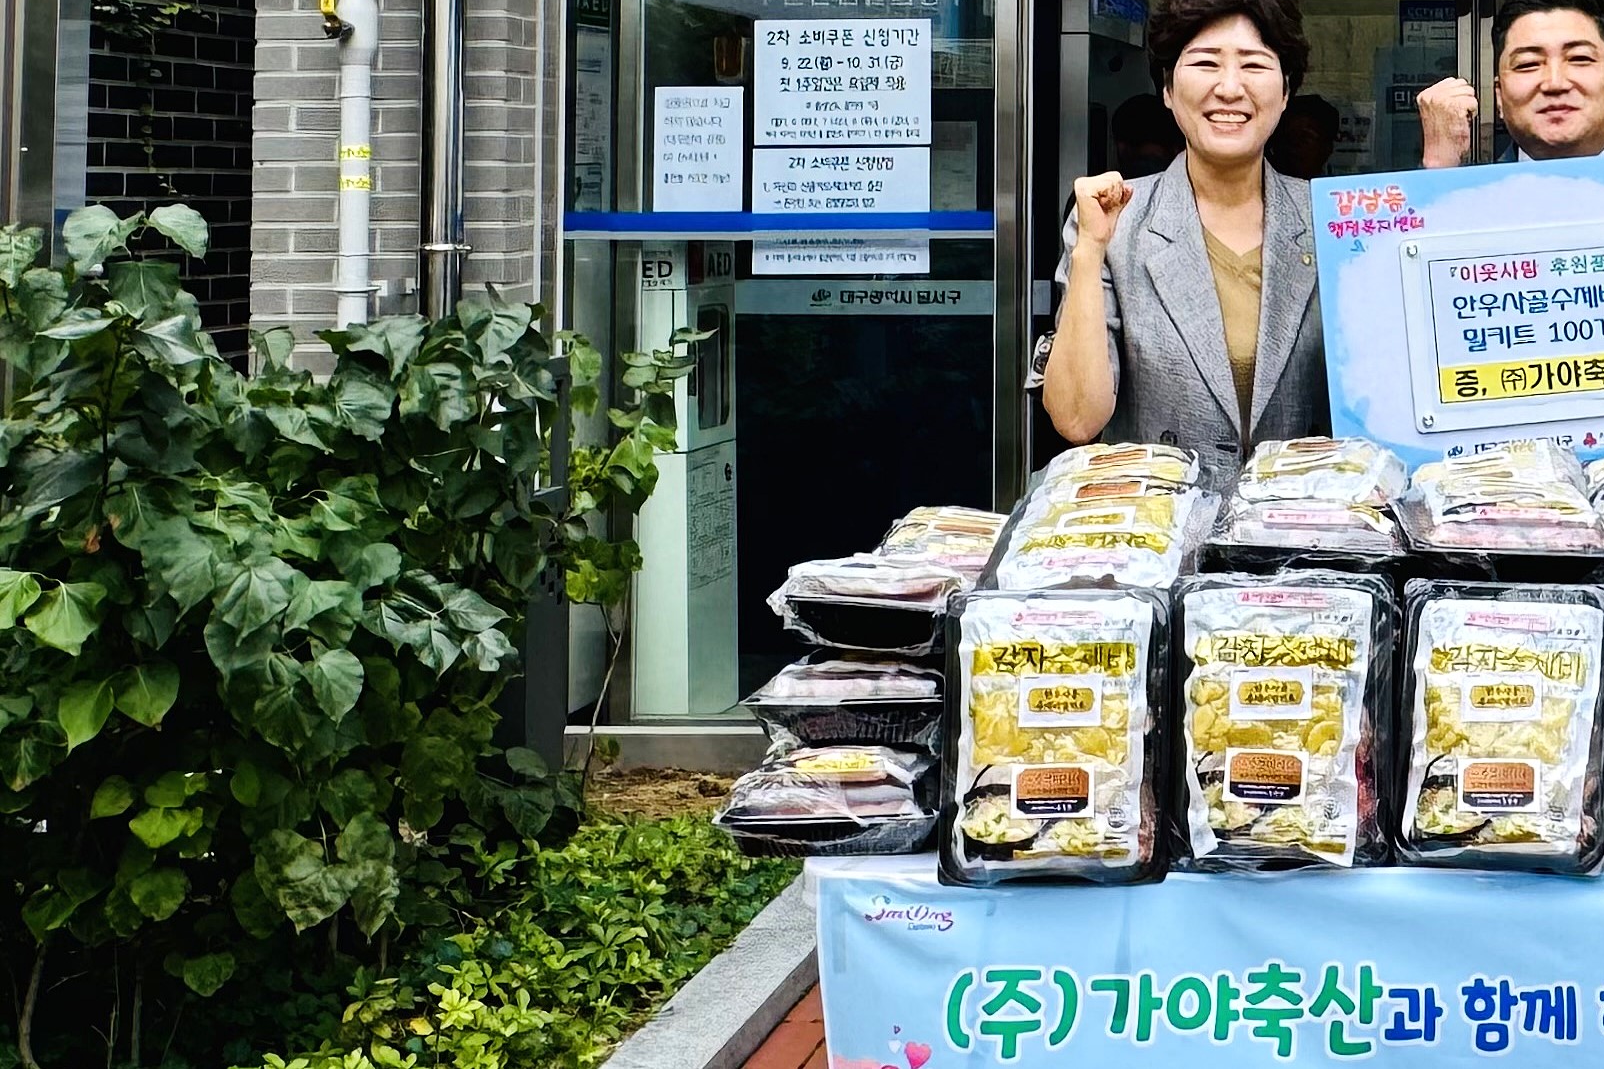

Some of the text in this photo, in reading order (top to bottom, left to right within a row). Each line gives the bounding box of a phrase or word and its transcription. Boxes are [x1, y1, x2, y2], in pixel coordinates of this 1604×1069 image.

[1455, 369, 1488, 398] 증,
[946, 961, 1443, 1058] (주)가야축산과
[1461, 978, 1578, 1052] 함께
